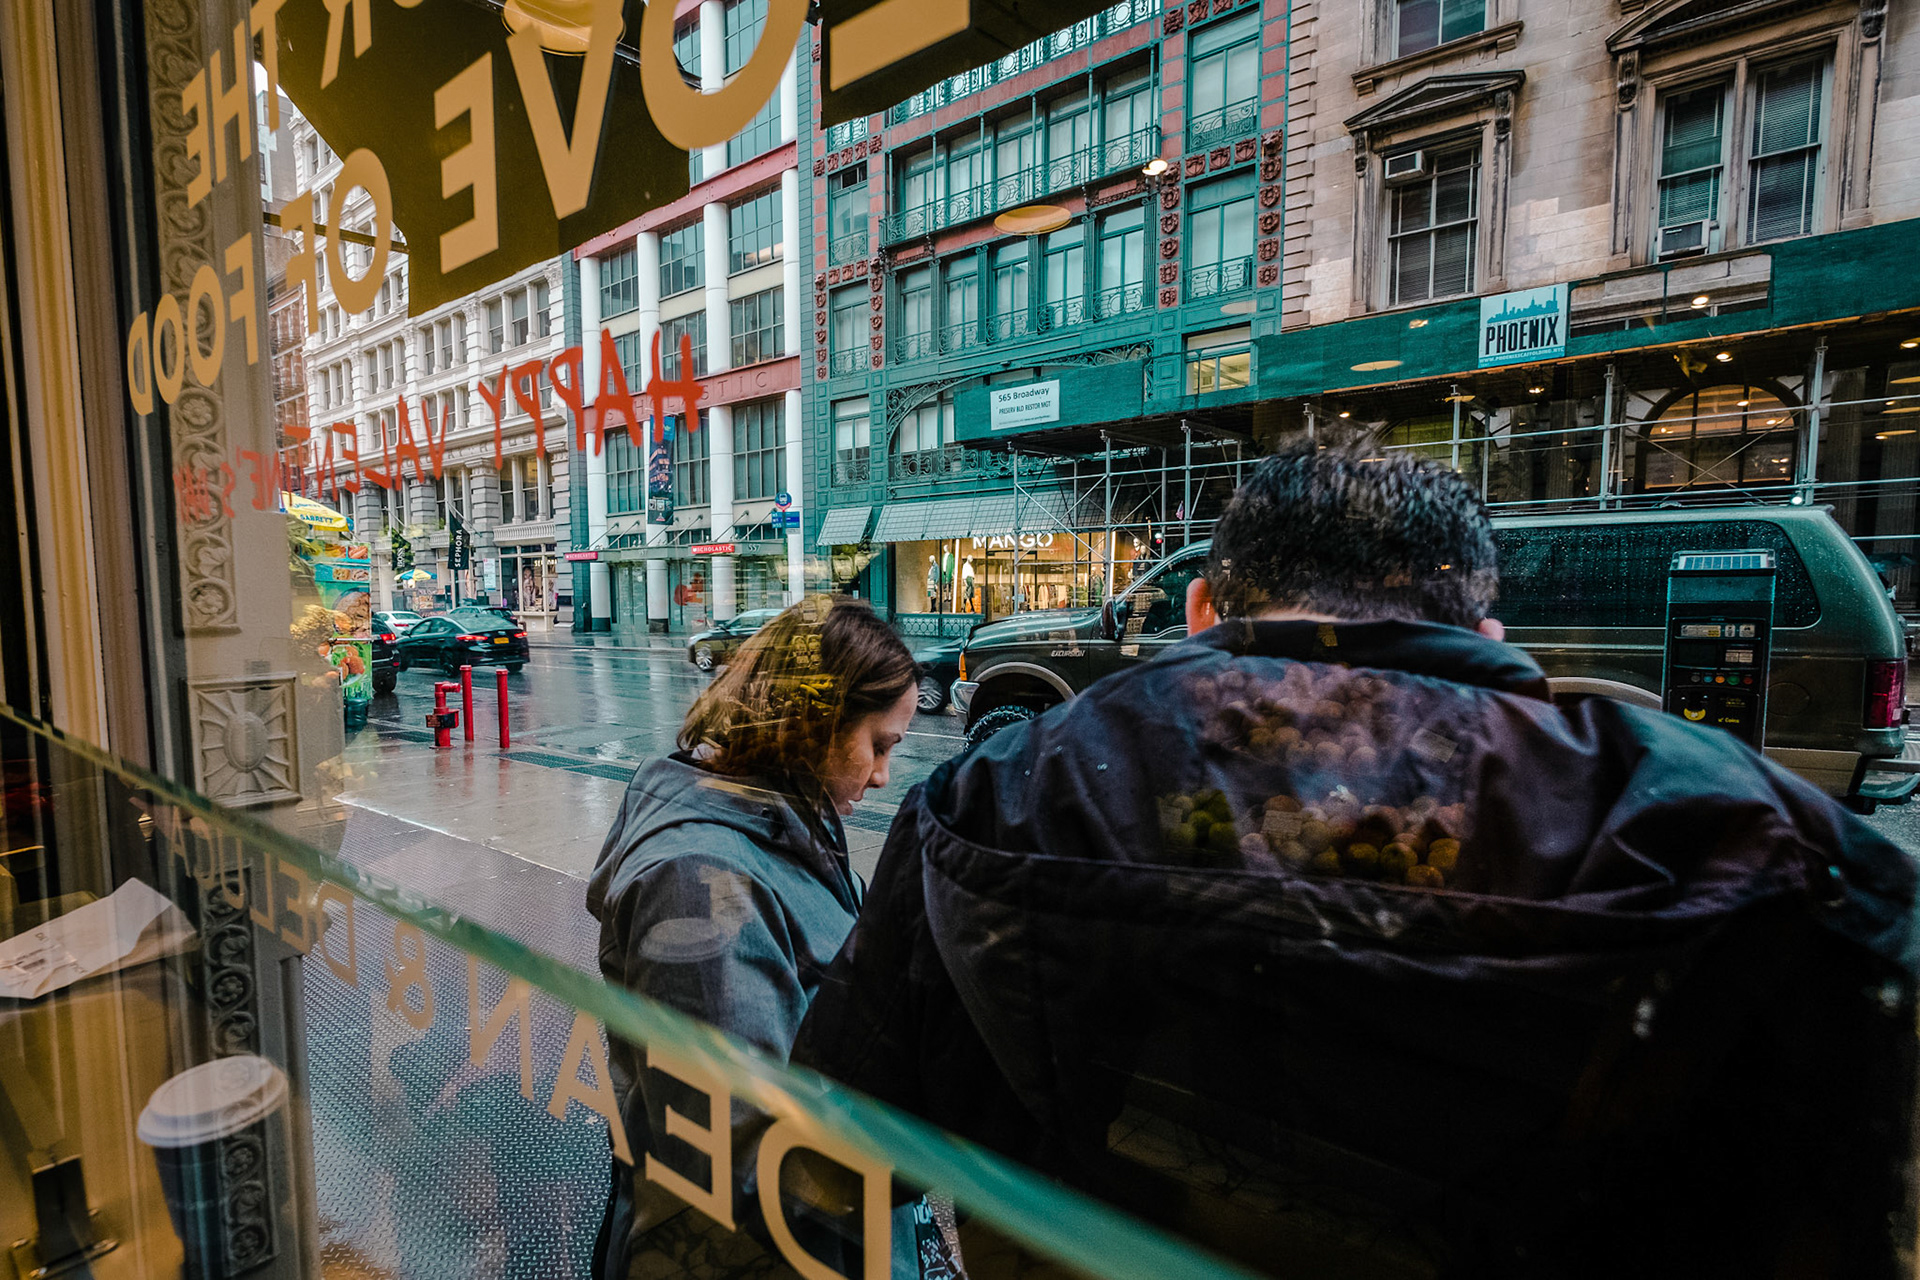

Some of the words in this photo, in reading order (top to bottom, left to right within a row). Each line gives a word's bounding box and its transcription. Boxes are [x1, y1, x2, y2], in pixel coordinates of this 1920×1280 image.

[1485, 316, 1558, 355] PHOENIX
[998, 393, 1012, 402] 565
[1013, 387, 1050, 400] Broadway
[454, 529, 463, 568] SEPHORA
[972, 532, 1054, 550] MANGO
[1051, 649, 1085, 657] EXCURSION
